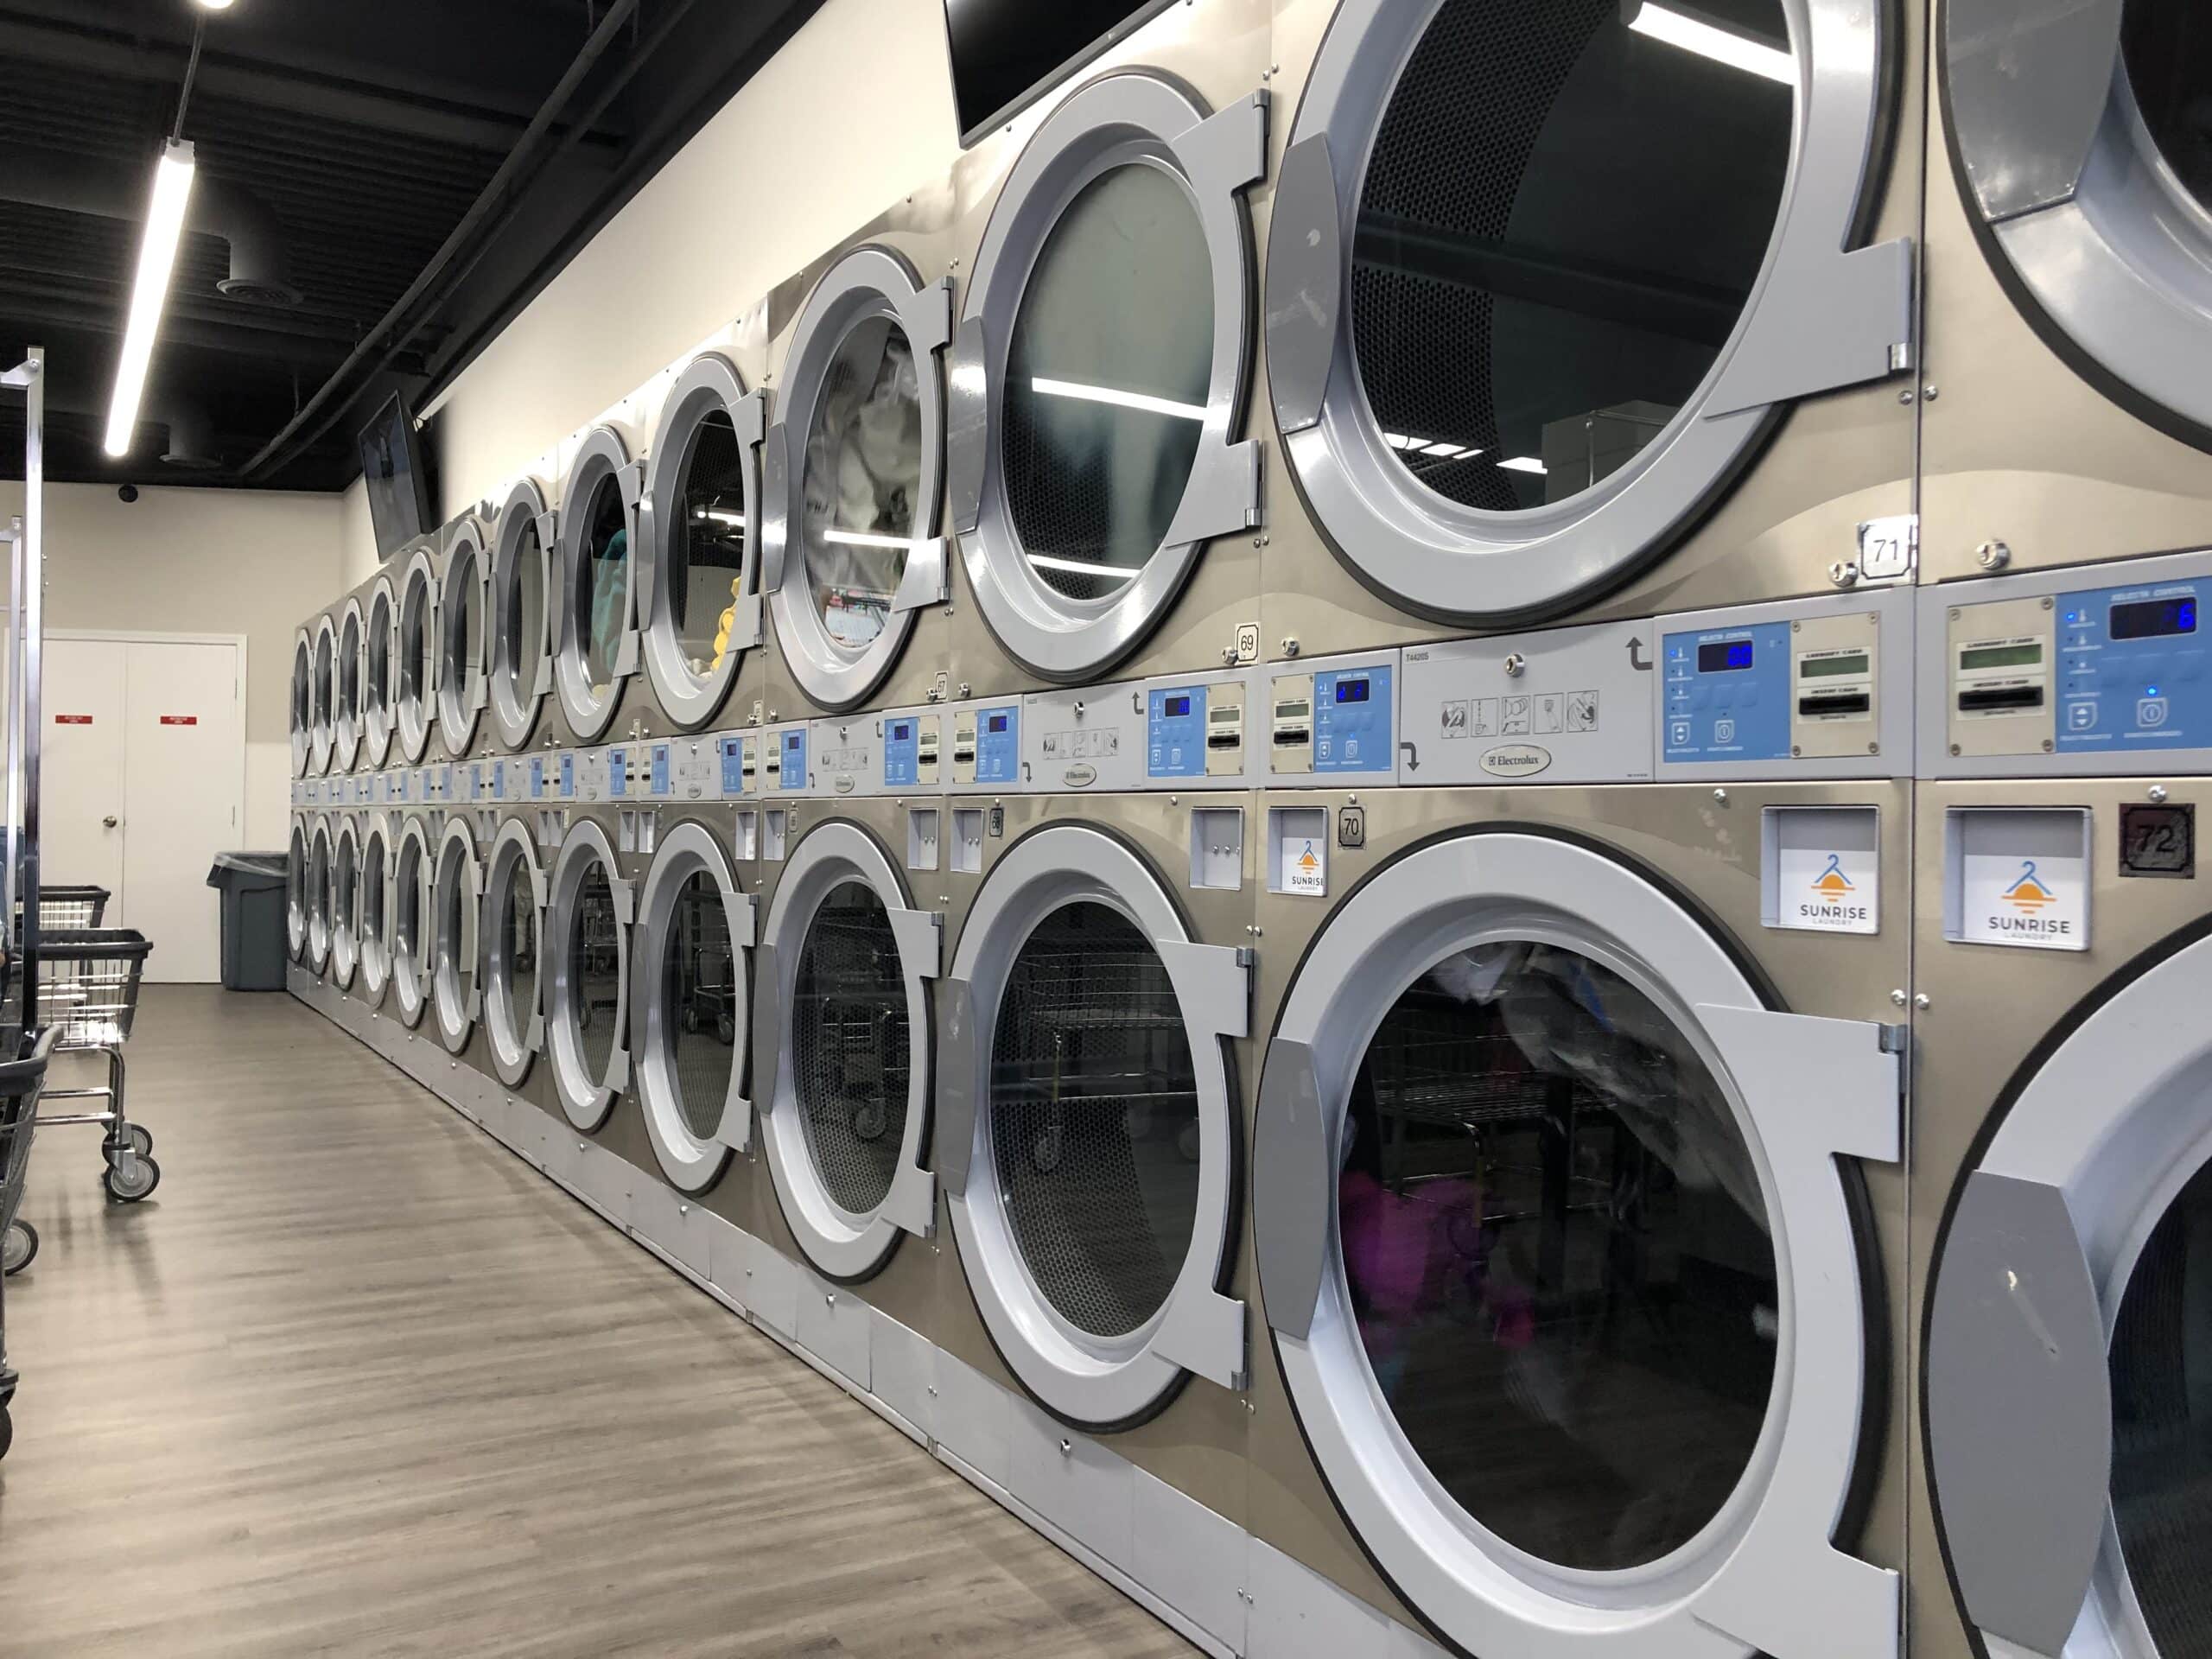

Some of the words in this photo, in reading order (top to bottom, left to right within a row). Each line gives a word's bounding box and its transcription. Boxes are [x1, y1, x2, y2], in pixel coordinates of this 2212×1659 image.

[1872, 538, 1898, 563] 71
[1241, 634, 1254, 651] 69
[1497, 755, 1539, 766] Electrolux
[1344, 817, 1359, 836] 70
[2137, 824, 2176, 853] 72
[1800, 904, 1867, 920] SUNRISE
[1988, 916, 2071, 934] SUNRISE
